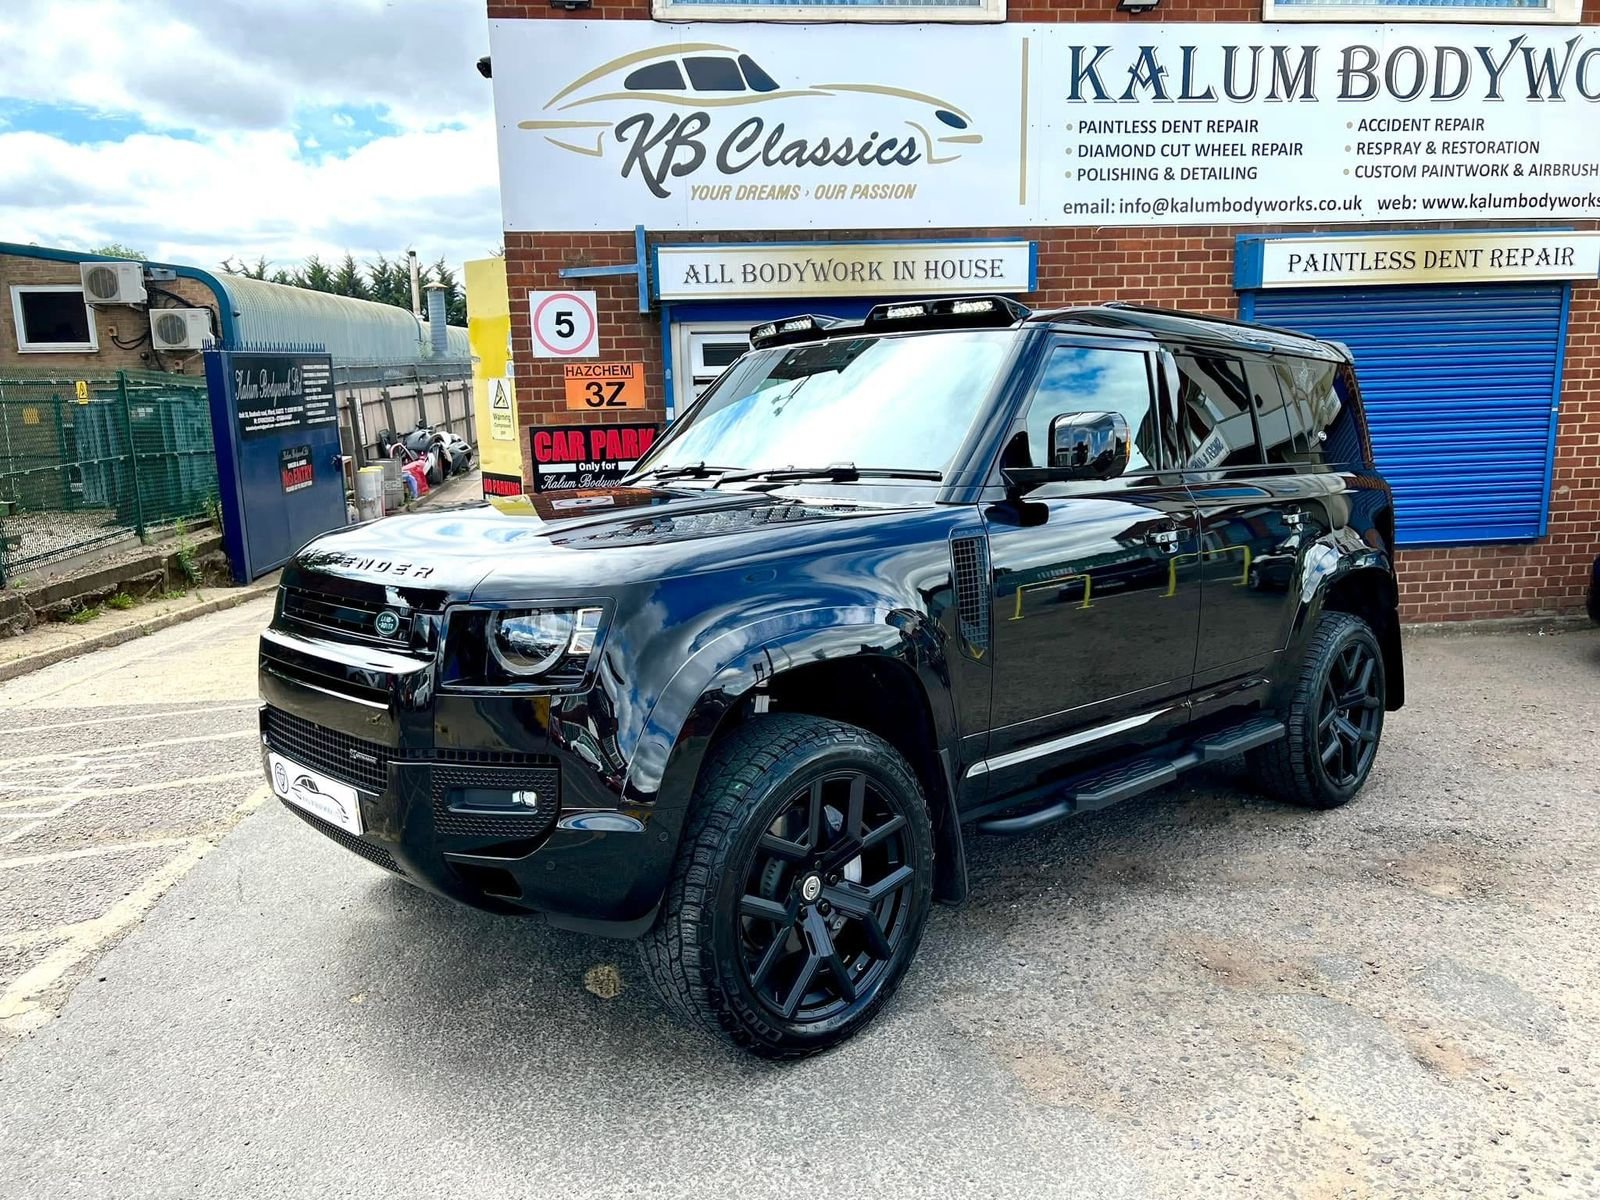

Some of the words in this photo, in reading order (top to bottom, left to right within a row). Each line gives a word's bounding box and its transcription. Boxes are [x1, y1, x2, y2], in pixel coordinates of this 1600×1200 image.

[1066, 45, 1321, 103] KALUM
[1078, 119, 1157, 134] PAINTLESS
[1161, 119, 1202, 133] DENT
[1206, 119, 1259, 133] REPAIR
[1357, 118, 1431, 132] ACCIDENT
[1434, 117, 1485, 131] REPAIR
[614, 111, 711, 200] KB
[716, 116, 922, 175] Classics
[1078, 143, 1156, 158] DIAMOND
[1160, 143, 1191, 157] CUT
[1194, 143, 1247, 157] WHEEL
[1251, 142, 1303, 156] REPAIR
[1356, 141, 1422, 155] RESPRAY
[1425, 141, 1437, 155] &
[1441, 140, 1540, 154] RESTORATION
[1077, 167, 1159, 182] POLISHING
[1163, 167, 1176, 181] &
[1180, 166, 1258, 180] DETAILING
[1354, 164, 1417, 179] CUSTOM
[1421, 163, 1509, 178] PAINTWORK
[1513, 163, 1524, 177] &
[1528, 163, 1599, 177] AIRBRUSH
[690, 184, 733, 202] YOUR
[735, 183, 801, 201] DREAMS
[814, 183, 848, 201] OUR
[850, 183, 918, 200] PASSION
[1063, 199, 1115, 215] email:
[1119, 194, 1363, 216] info@kalumbodyworks.co.uk
[1377, 193, 1417, 211] web:
[1287, 250, 1416, 273] PAINTLESS
[1423, 249, 1484, 270] DENT
[1489, 246, 1576, 268] REPAIR
[683, 263, 734, 285] ALL
[741, 257, 884, 284] BODYWORK
[892, 260, 916, 281] IN
[924, 258, 1005, 280] HOUSE
[555, 311, 575, 338] 5
[565, 365, 631, 377] HAZCHEM
[585, 381, 627, 407] 3Z
[534, 430, 586, 462] CAR
[590, 428, 656, 461] PARK
[578, 462, 600, 472] Only
[601, 461, 616, 471] for
[493, 480, 520, 495] PARKING
[541, 474, 577, 490] Kalum
